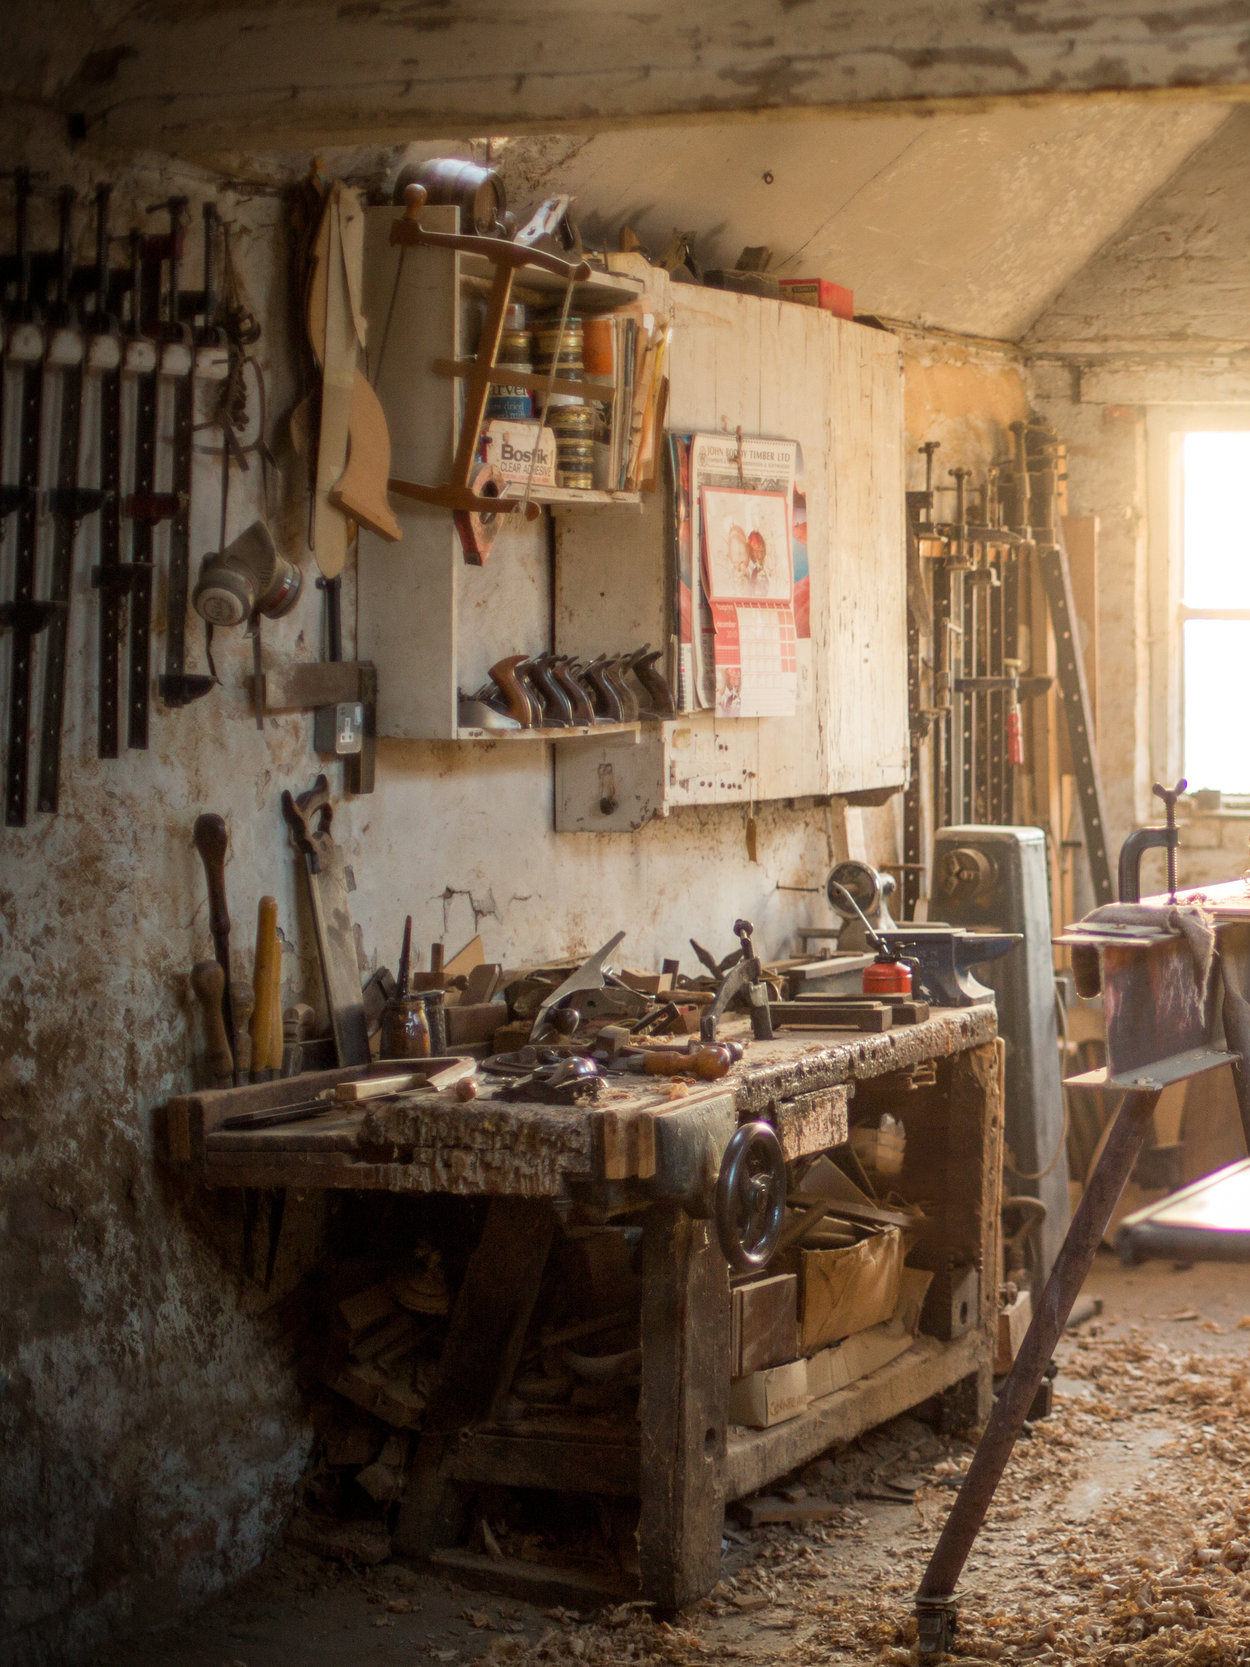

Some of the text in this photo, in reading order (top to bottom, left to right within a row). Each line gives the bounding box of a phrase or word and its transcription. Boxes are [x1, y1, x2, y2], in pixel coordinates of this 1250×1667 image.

[707, 446, 724, 457] JOHN
[749, 450, 774, 461] TIMBER
[777, 453, 791, 462] LTD
[501, 462, 552, 477] CLEAR ADESIVE
